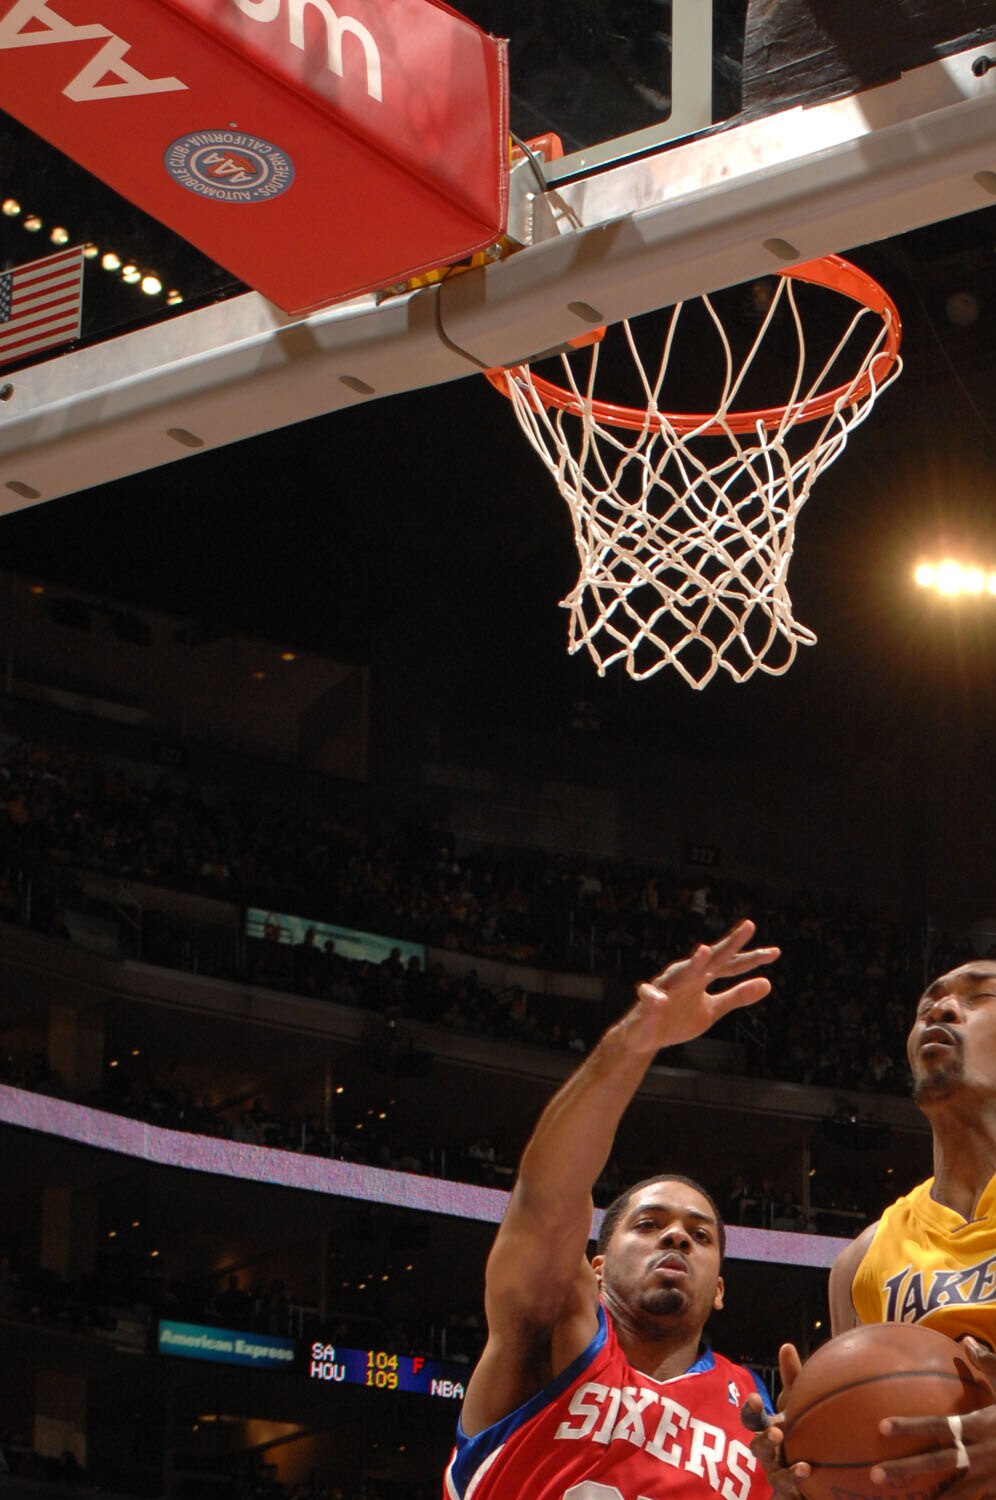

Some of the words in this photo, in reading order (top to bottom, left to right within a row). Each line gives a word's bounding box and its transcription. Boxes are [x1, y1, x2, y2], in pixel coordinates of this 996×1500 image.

[169, 145, 191, 168] CLUB
[188, 133, 272, 154] CALIFORNIA
[202, 152, 253, 183] AAA
[257, 152, 290, 197] SOUTHERN
[170, 167, 251, 201] AUTOMOBILE
[160, 1329, 234, 1353] American
[234, 1340, 295, 1361] Express
[311, 1342, 335, 1362] SA
[366, 1350, 398, 1372] 104
[412, 1357, 425, 1375] F
[310, 1361, 346, 1382] HOU
[366, 1370, 398, 1390] 109
[431, 1379, 465, 1400] NBA
